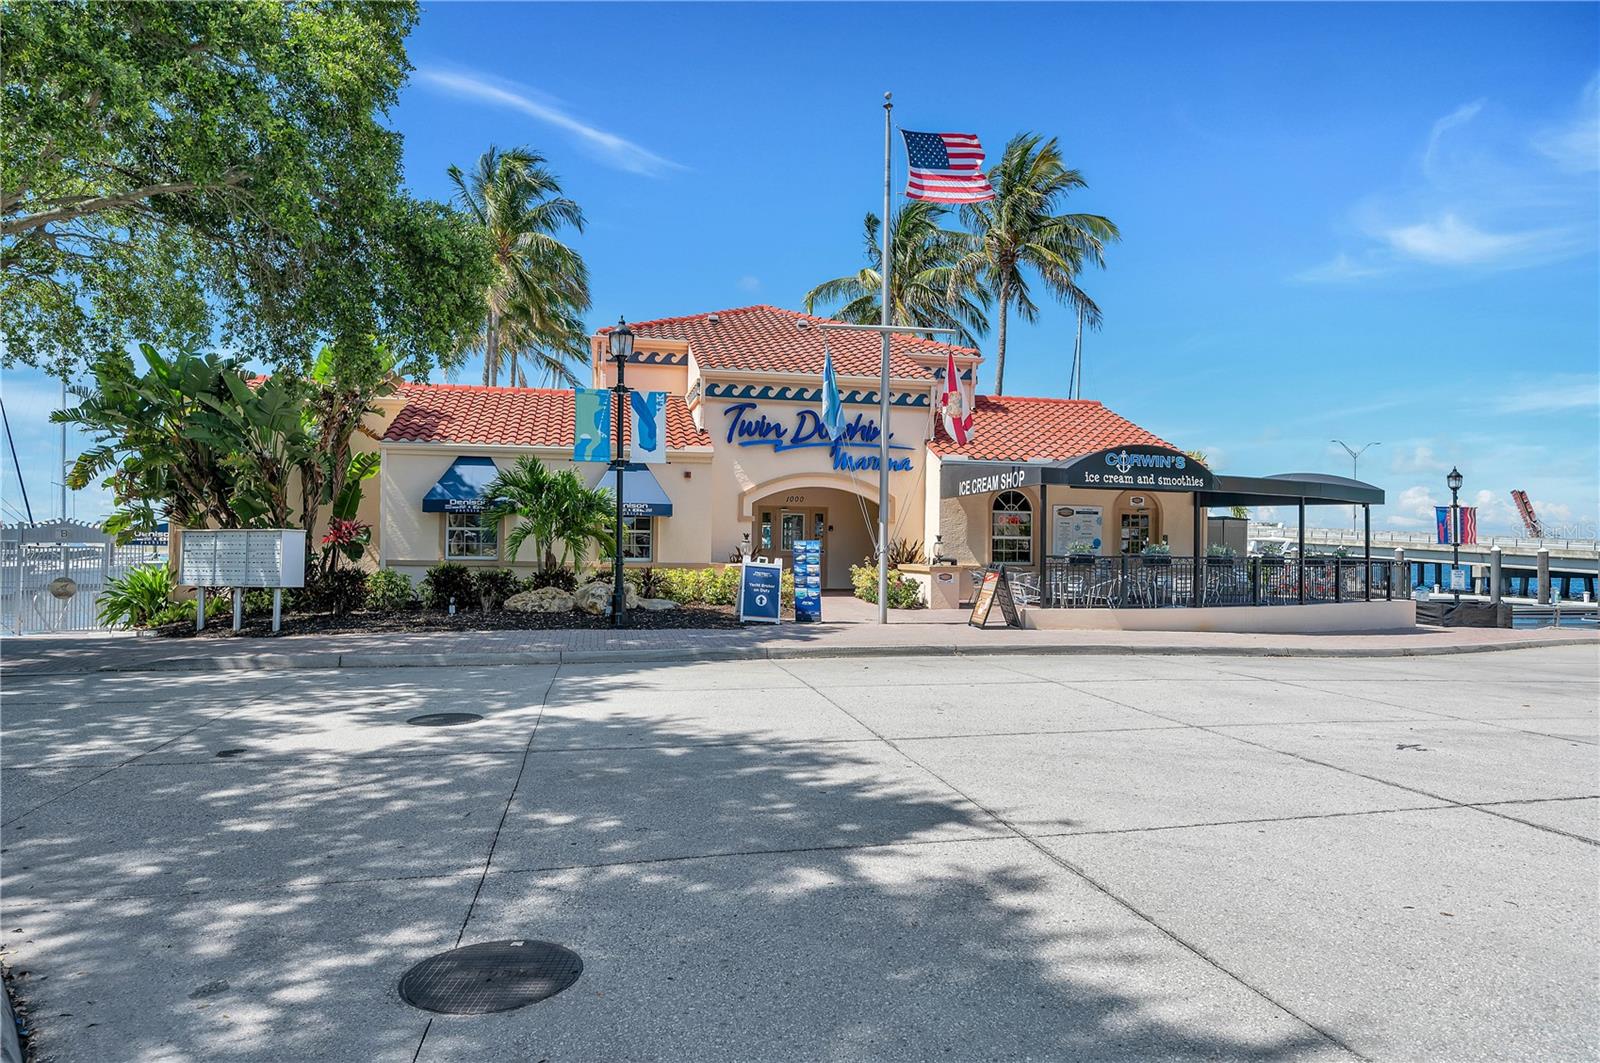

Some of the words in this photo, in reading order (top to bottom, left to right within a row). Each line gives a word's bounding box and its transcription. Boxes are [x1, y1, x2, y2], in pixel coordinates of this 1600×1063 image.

[723, 403, 788, 444] Twin
[790, 409, 893, 456] Dophin
[832, 446, 914, 472] Marna
[1104, 452, 1186, 470] CORWIN'S
[958, 480, 971, 496] ICE
[971, 475, 999, 494] CREAM
[1000, 470, 1025, 489] SHOP
[1085, 471, 1101, 483] ice
[1103, 472, 1135, 485] cream
[1137, 474, 1156, 485] and
[1158, 475, 1204, 487] smoothies
[785, 495, 805, 504] 1000
